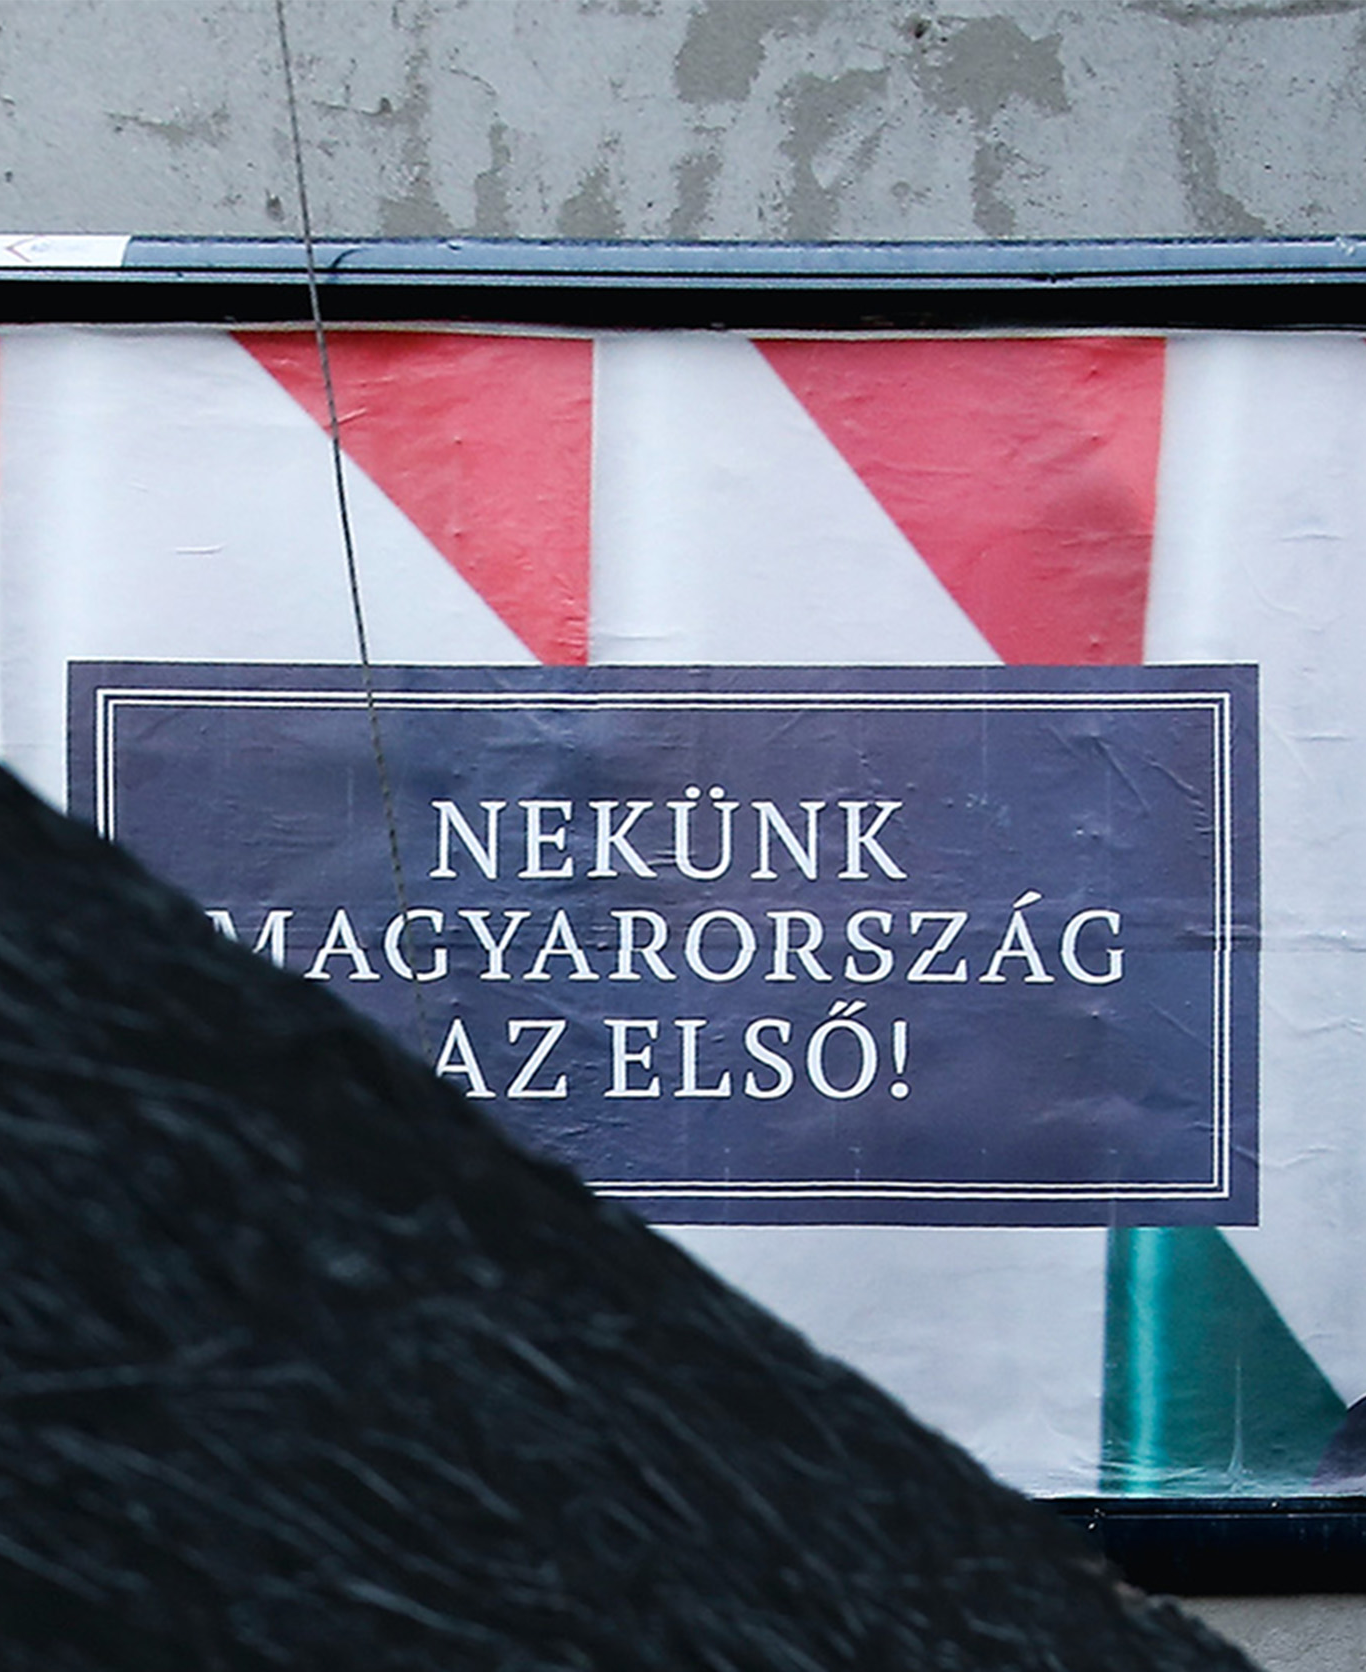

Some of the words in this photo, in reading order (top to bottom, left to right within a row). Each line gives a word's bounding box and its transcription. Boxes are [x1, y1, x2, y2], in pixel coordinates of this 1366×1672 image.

[429, 785, 908, 881] NEKÜNK
[204, 890, 1126, 984] MAGYARORSZÁG
[436, 1017, 568, 1099] AZ
[602, 999, 910, 1100] ELSŐ!
